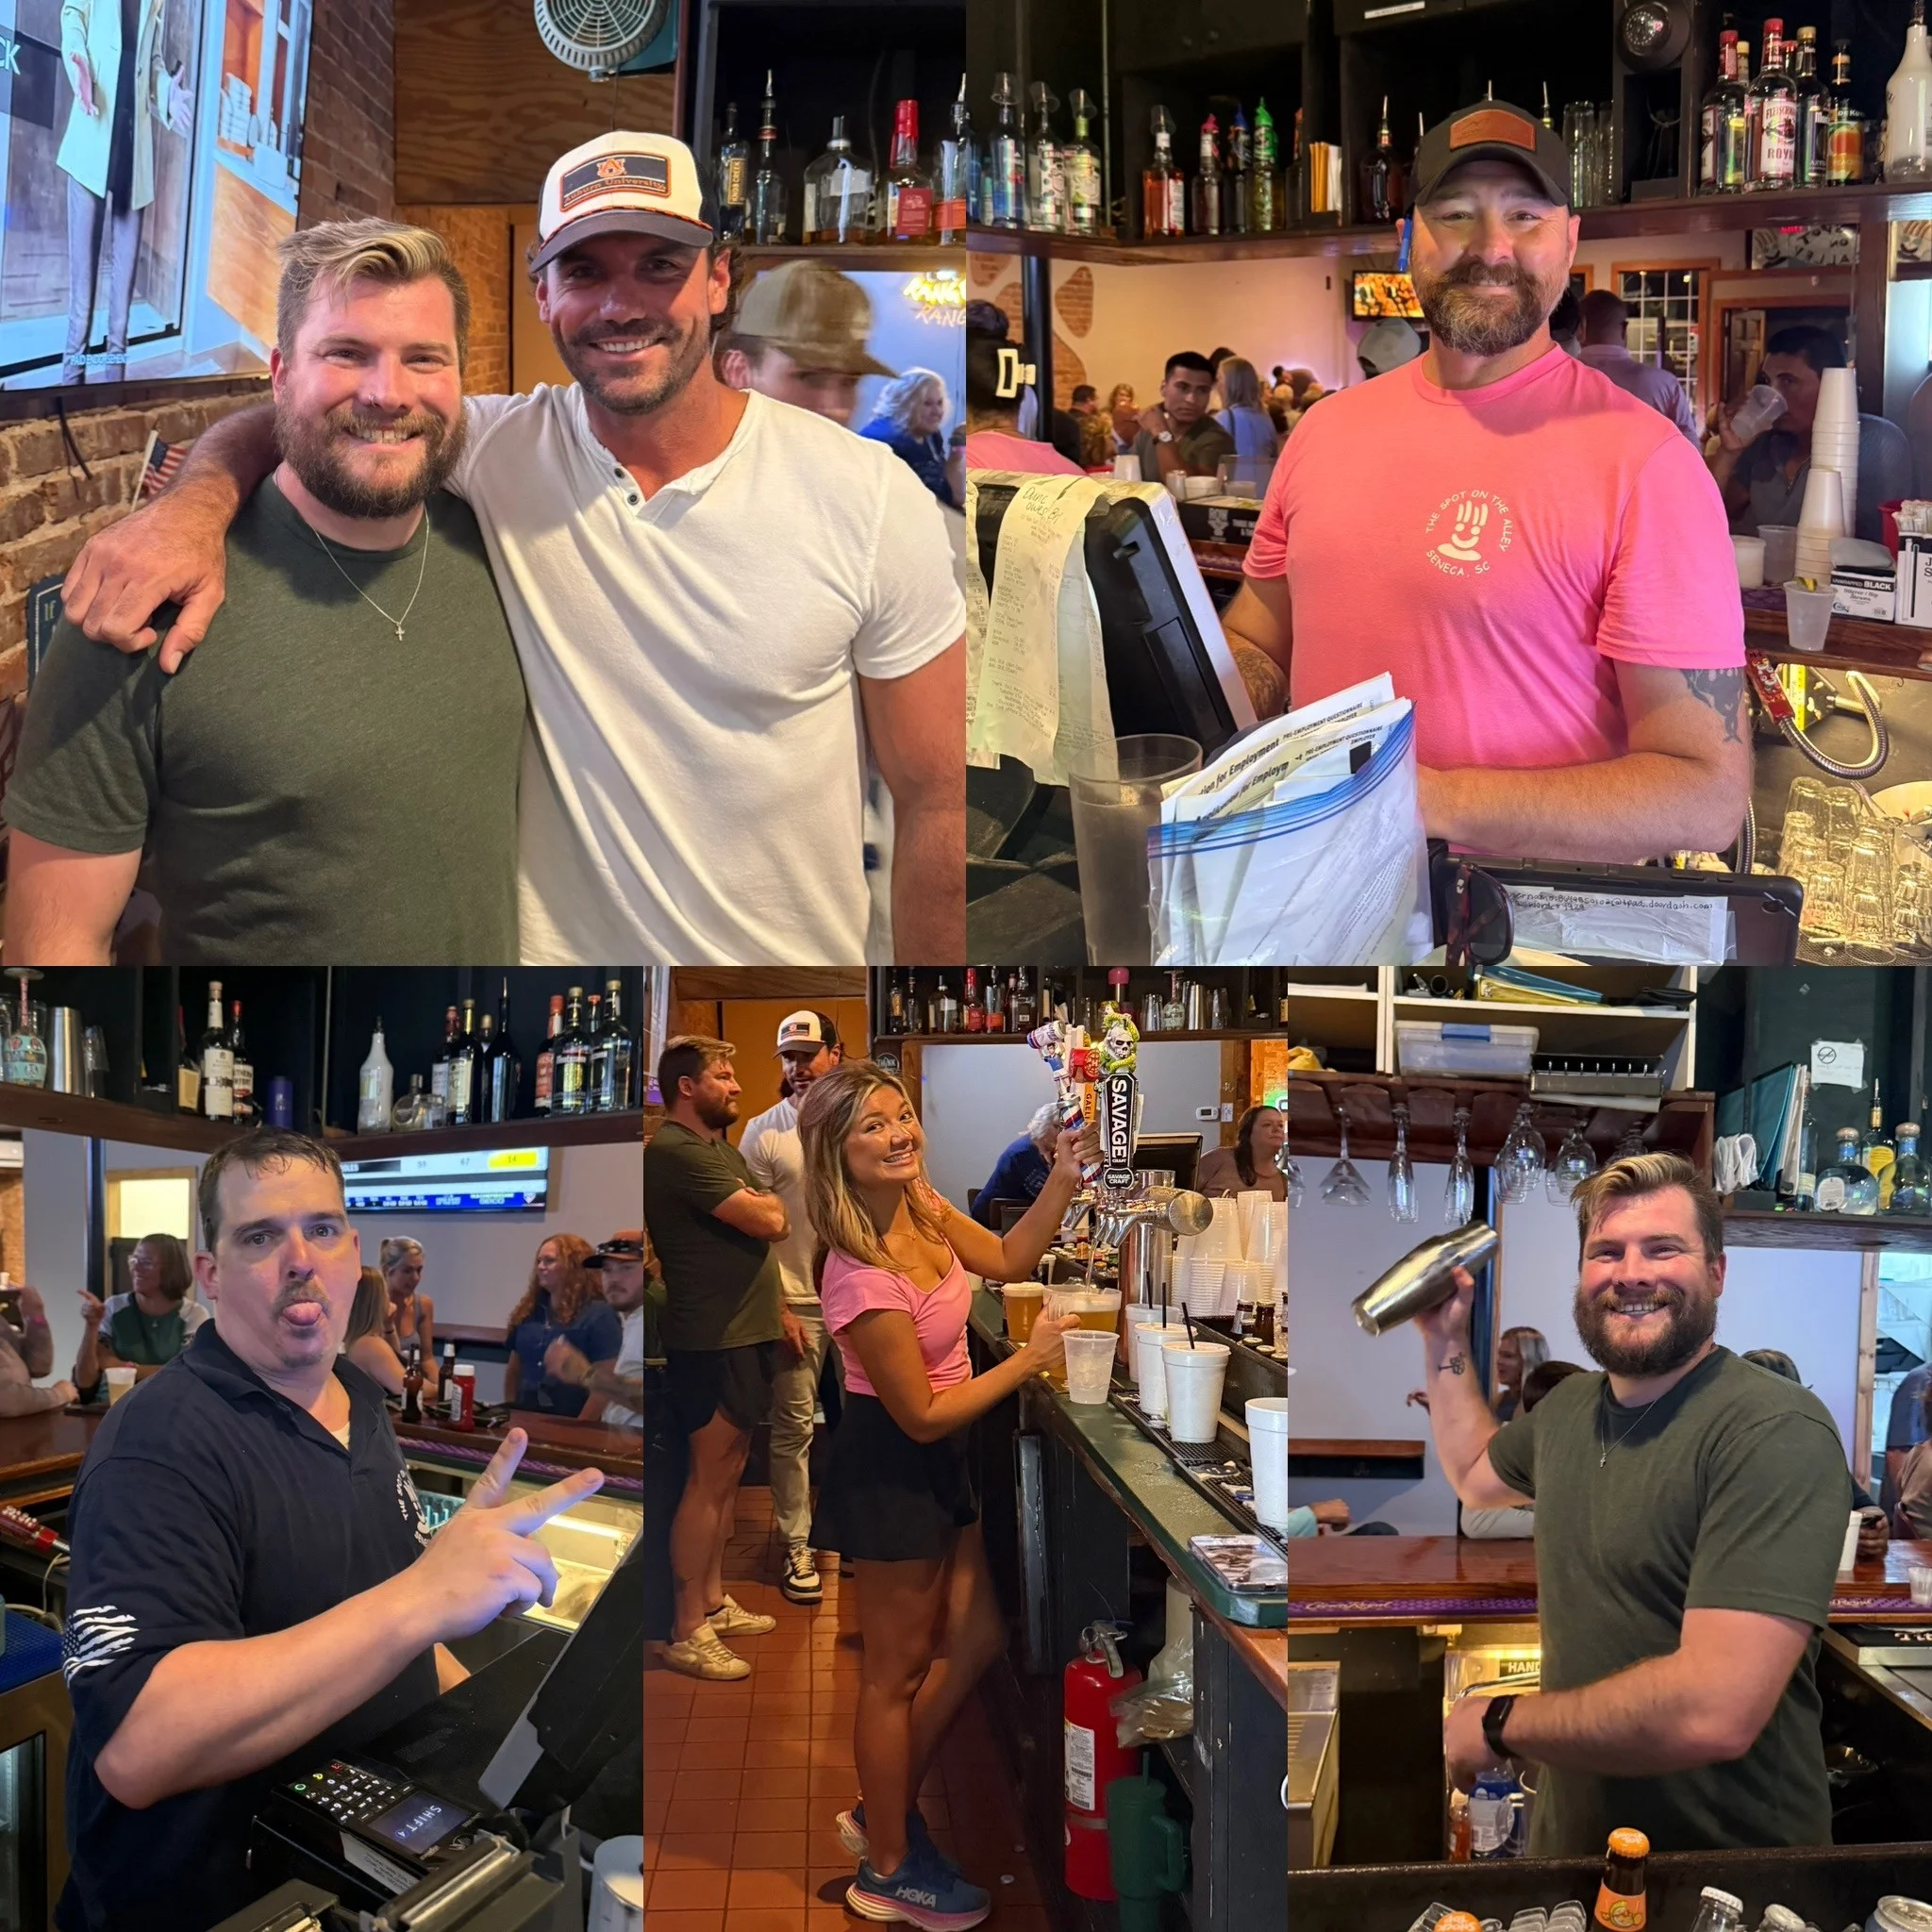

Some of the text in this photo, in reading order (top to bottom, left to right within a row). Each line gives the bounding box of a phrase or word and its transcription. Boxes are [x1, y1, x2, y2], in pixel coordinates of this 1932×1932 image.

[564, 177, 667, 203] Auburn University
[1425, 489, 1513, 552] THE SPOT ON THE ALLEY
[1474, 560, 1491, 575] SC
[1864, 579, 1892, 591] BLACK
[1283, 702, 1364, 741] PRE-EMPLOYMENT QUESTIONNAIRE
[1305, 736, 1346, 755] PRE-EMPLOYMENT
[1345, 725, 1384, 741] QUESTIONNAIRE
[1351, 734, 1376, 744] EMPLOYER
[1215, 770, 1228, 790] for
[1228, 738, 1280, 775] Employment
[1111, 1079, 1127, 1158] SAVAGE
[406, 1805, 442, 1832] SHIFT
[894, 1885, 937, 1907] HOKA
